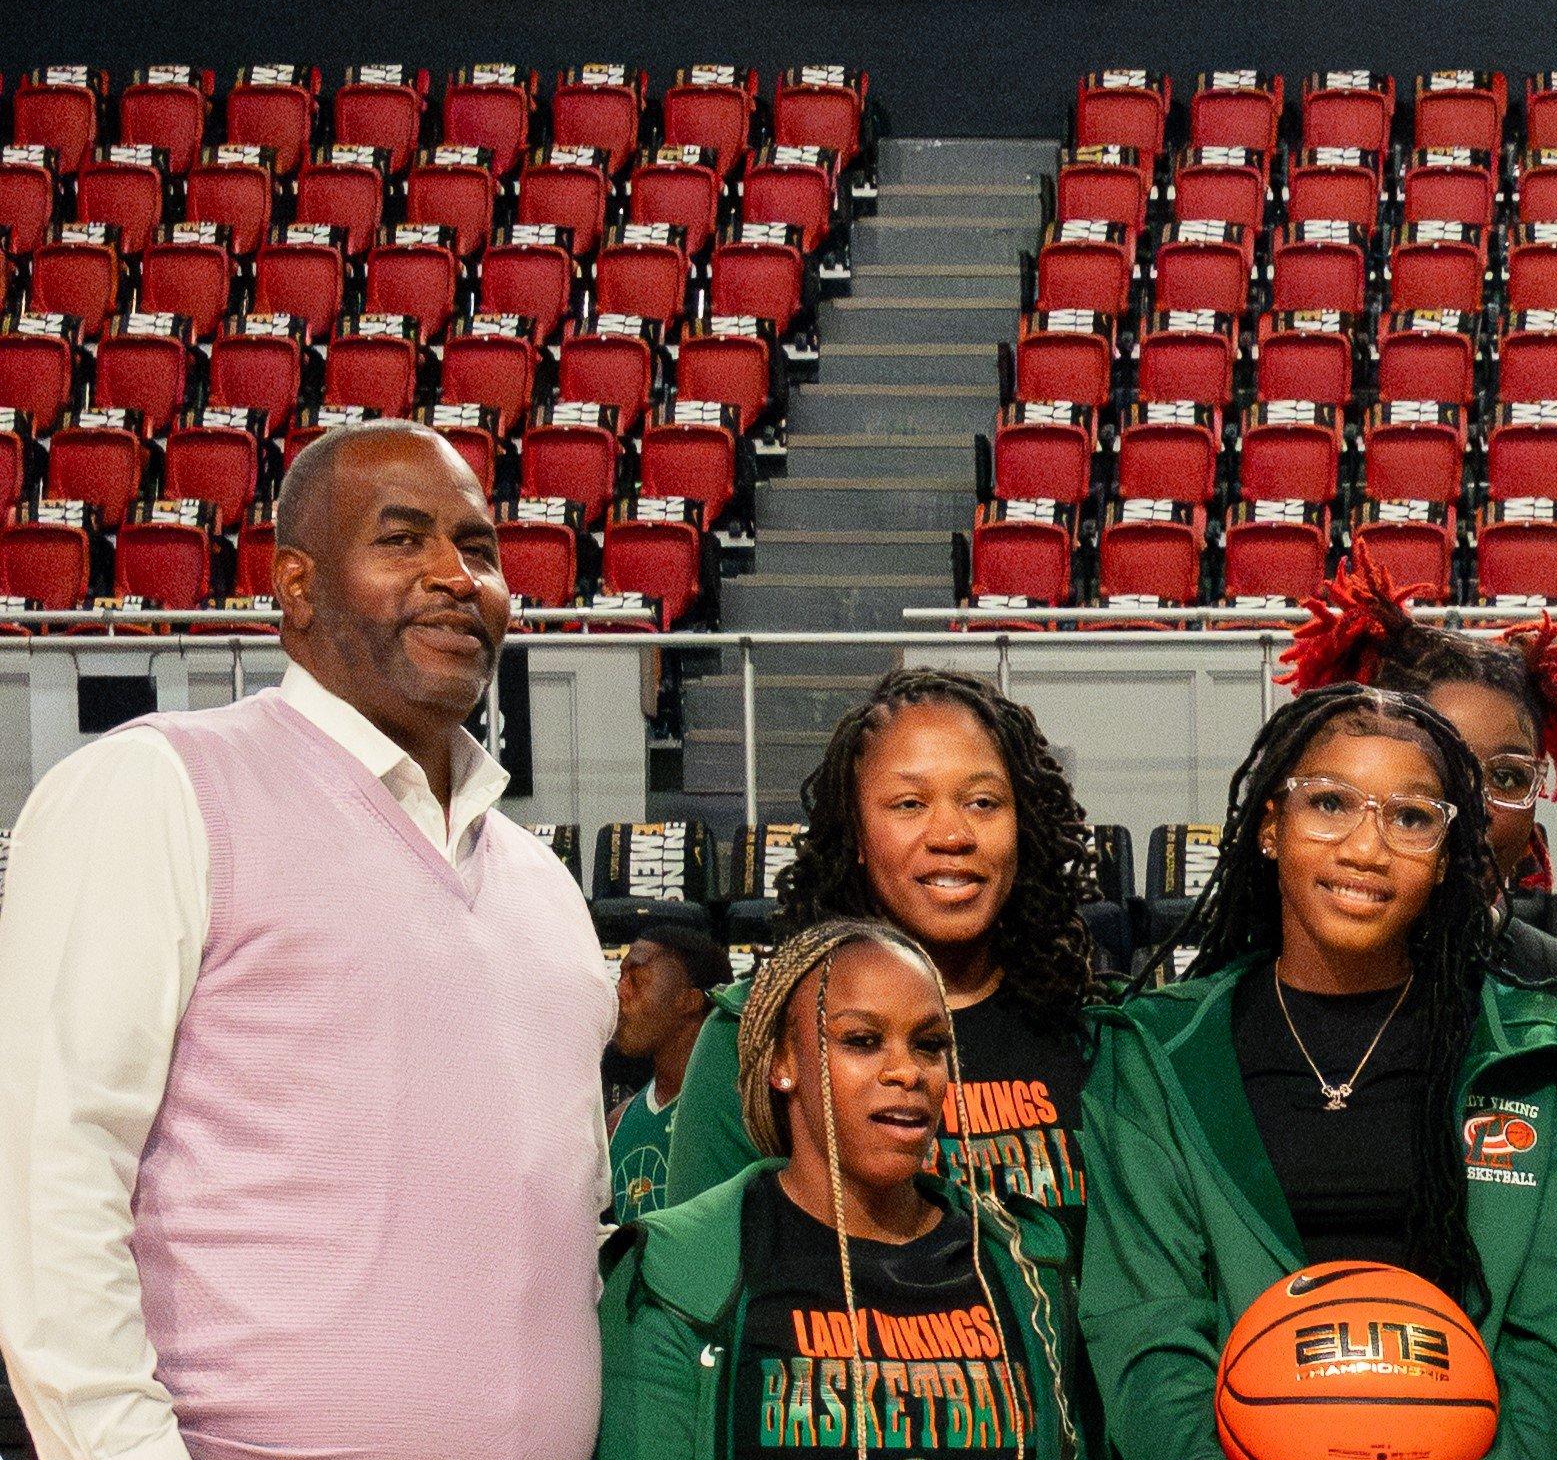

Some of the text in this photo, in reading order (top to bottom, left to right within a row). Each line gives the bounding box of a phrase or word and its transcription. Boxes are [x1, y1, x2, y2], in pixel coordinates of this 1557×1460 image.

[792, 1306, 1001, 1360] LADY VIKINGS
[1295, 1320, 1450, 1371] ELITE
